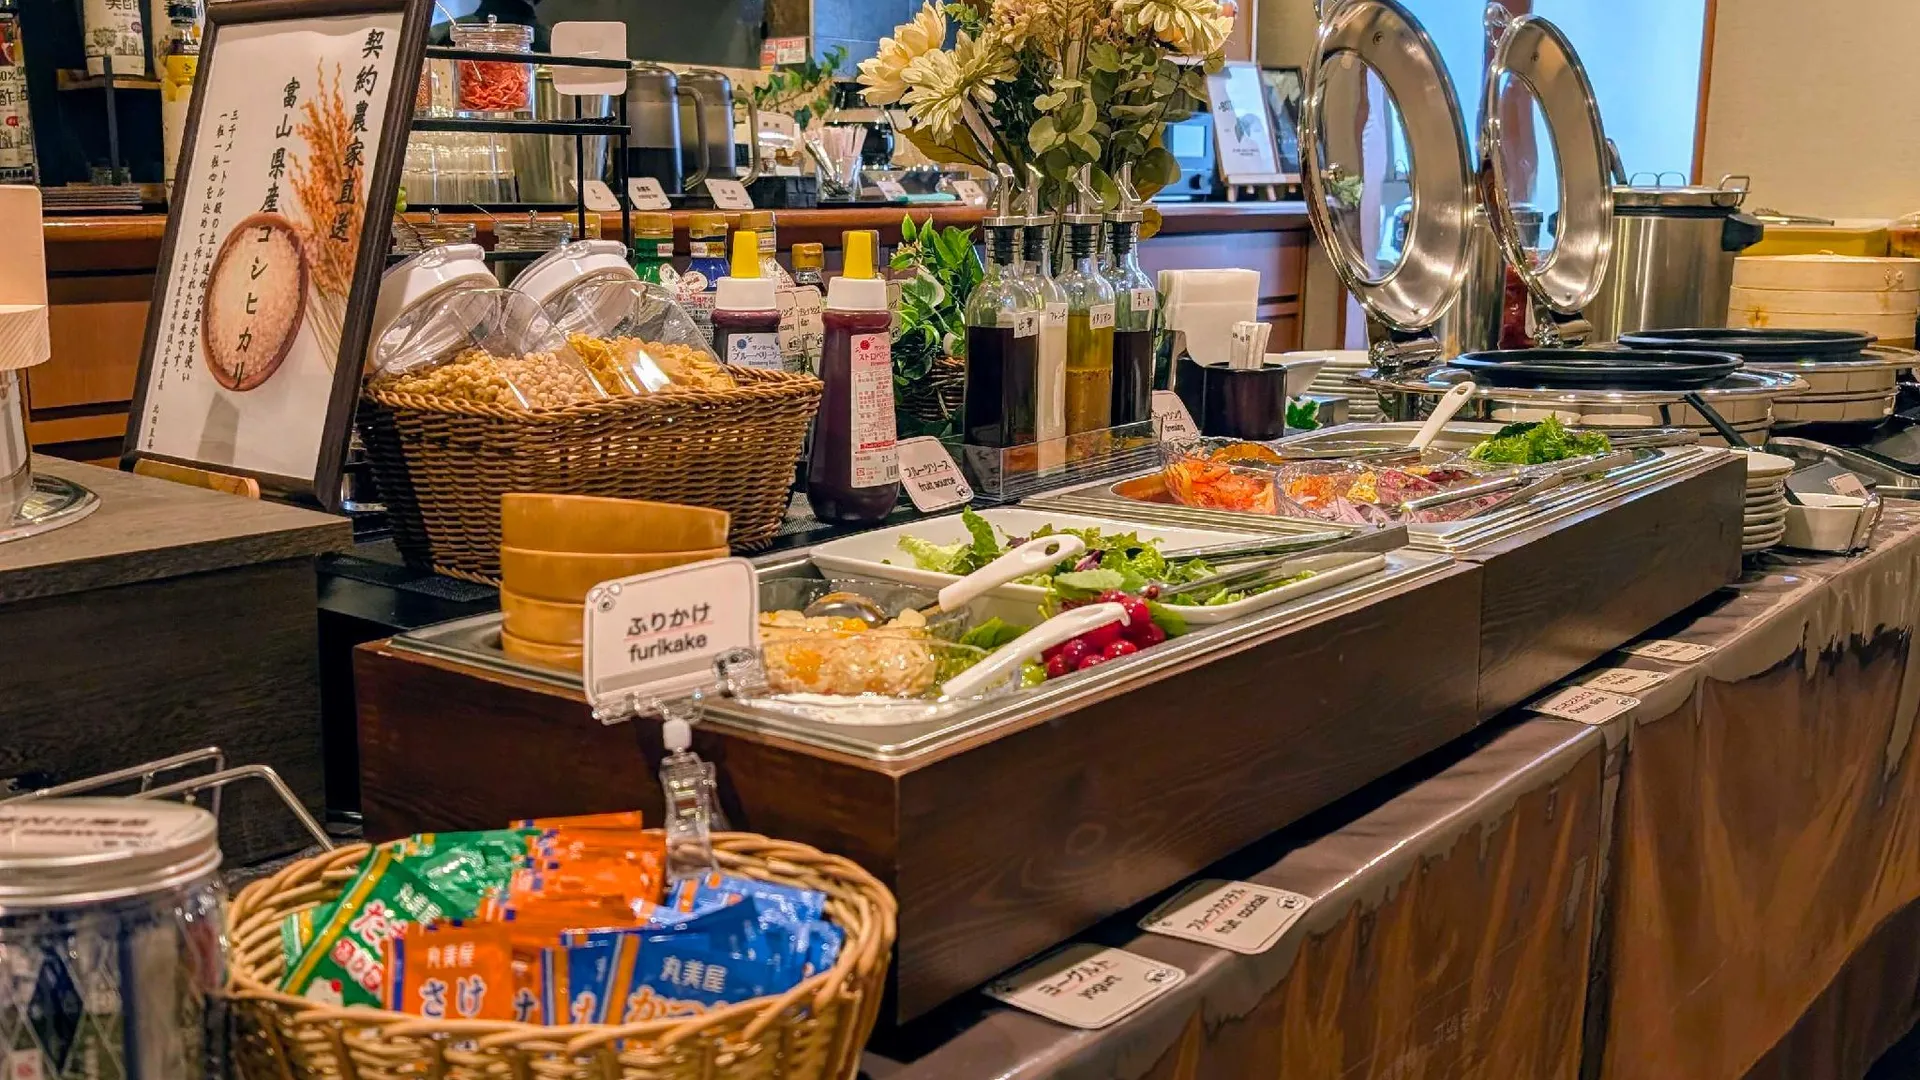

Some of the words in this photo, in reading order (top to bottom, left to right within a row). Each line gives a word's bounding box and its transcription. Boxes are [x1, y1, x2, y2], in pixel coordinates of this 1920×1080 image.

[329, 28, 384, 242] 契約農家直送
[232, 77, 300, 389] 富山県産コシヒカリ
[904, 460, 951, 478] フルーツソース
[626, 601, 712, 637] ふりかけ
[628, 633, 708, 663] furikake
[1186, 888, 1247, 931] フルーツカクテル
[427, 942, 476, 969] 丸美屋
[659, 954, 728, 994] 丸美屋
[418, 973, 487, 1019] さけ
[1037, 959, 1109, 997] ヨーグルト
